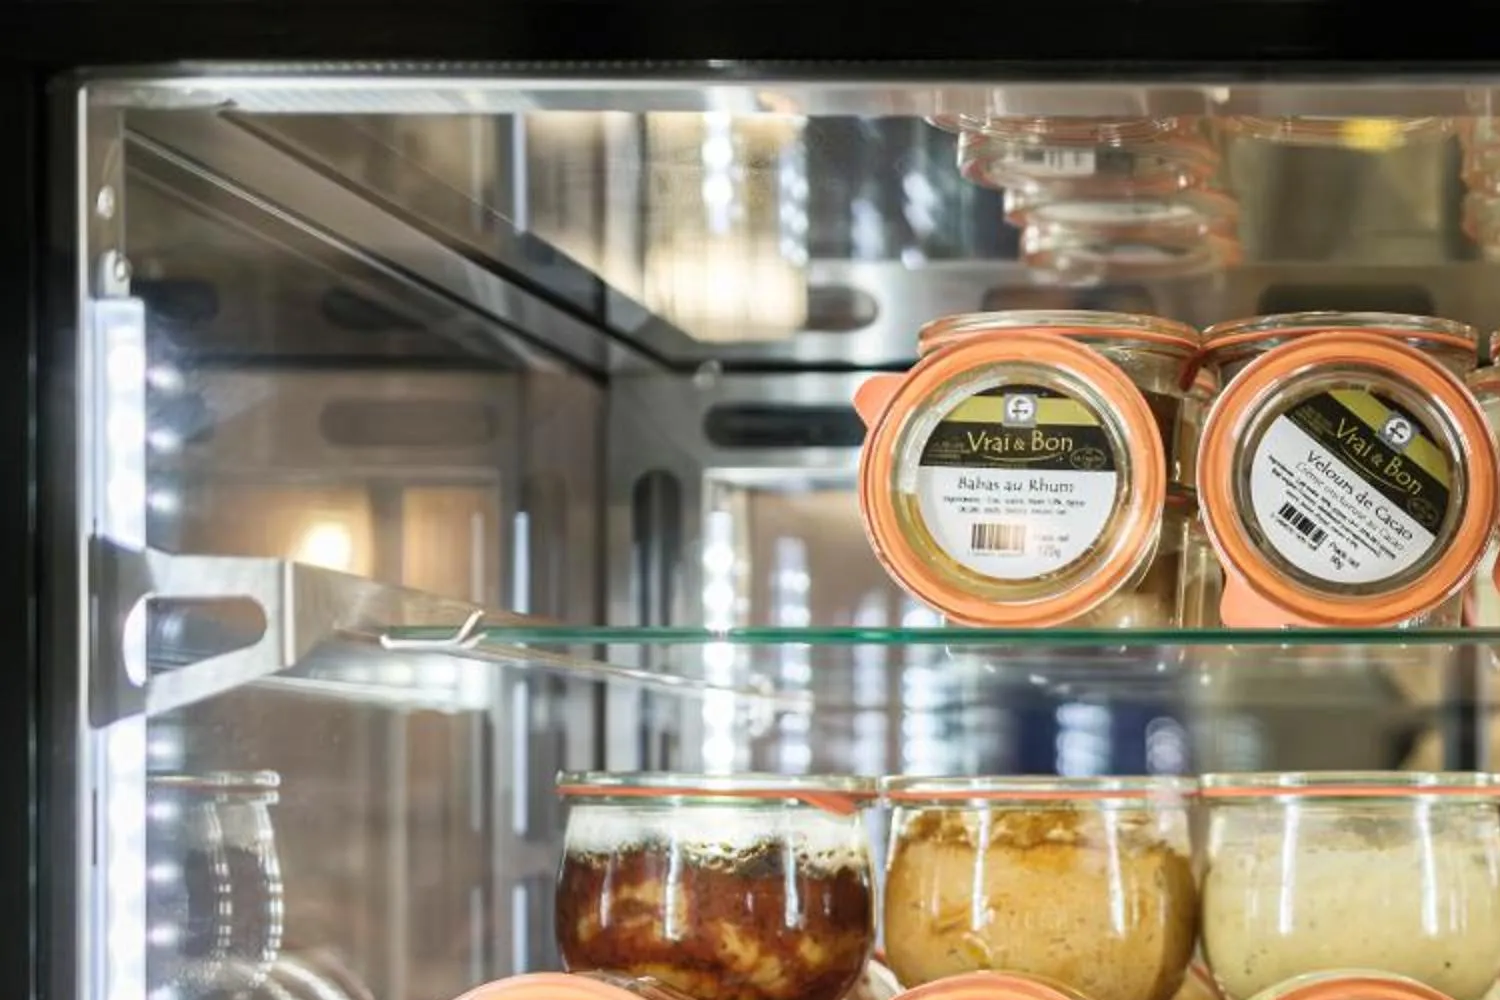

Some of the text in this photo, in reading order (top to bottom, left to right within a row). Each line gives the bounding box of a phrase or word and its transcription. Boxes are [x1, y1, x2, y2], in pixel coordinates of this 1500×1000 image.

[967, 431, 1010, 453] Vrai
[1013, 437, 1026, 451] &
[1031, 430, 1073, 453] Bon
[1336, 417, 1371, 459] Vrai
[1371, 453, 1384, 467] &
[1384, 456, 1423, 496] Bon
[1003, 480, 1023, 492] au
[1306, 450, 1354, 496] Velours
[1356, 491, 1374, 509] de
[1375, 506, 1414, 541] Cacao
